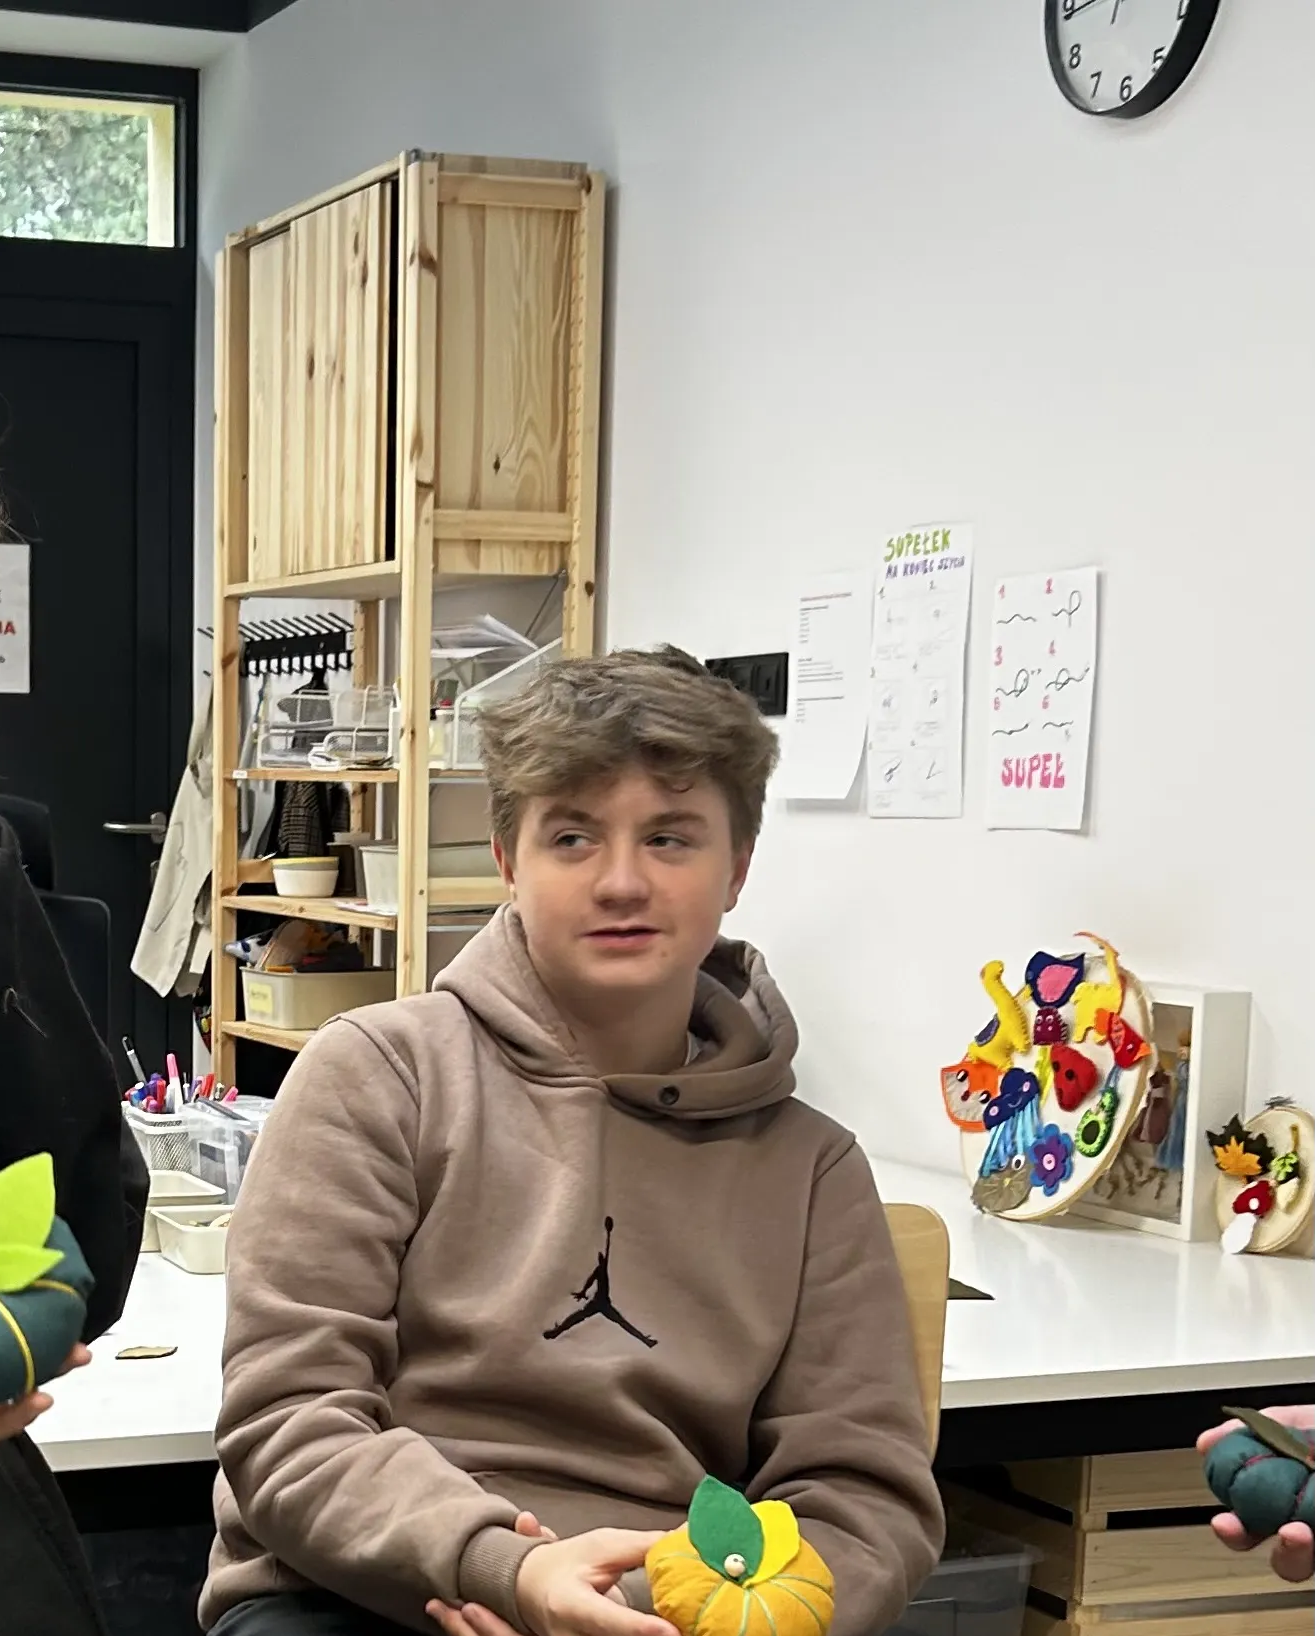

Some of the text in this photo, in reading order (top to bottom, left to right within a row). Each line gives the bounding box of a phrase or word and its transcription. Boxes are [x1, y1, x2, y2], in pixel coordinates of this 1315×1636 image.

[1068, 43, 1081, 69] 8
[1089, 70, 1102, 99] 7
[1119, 75, 1132, 101] 6
